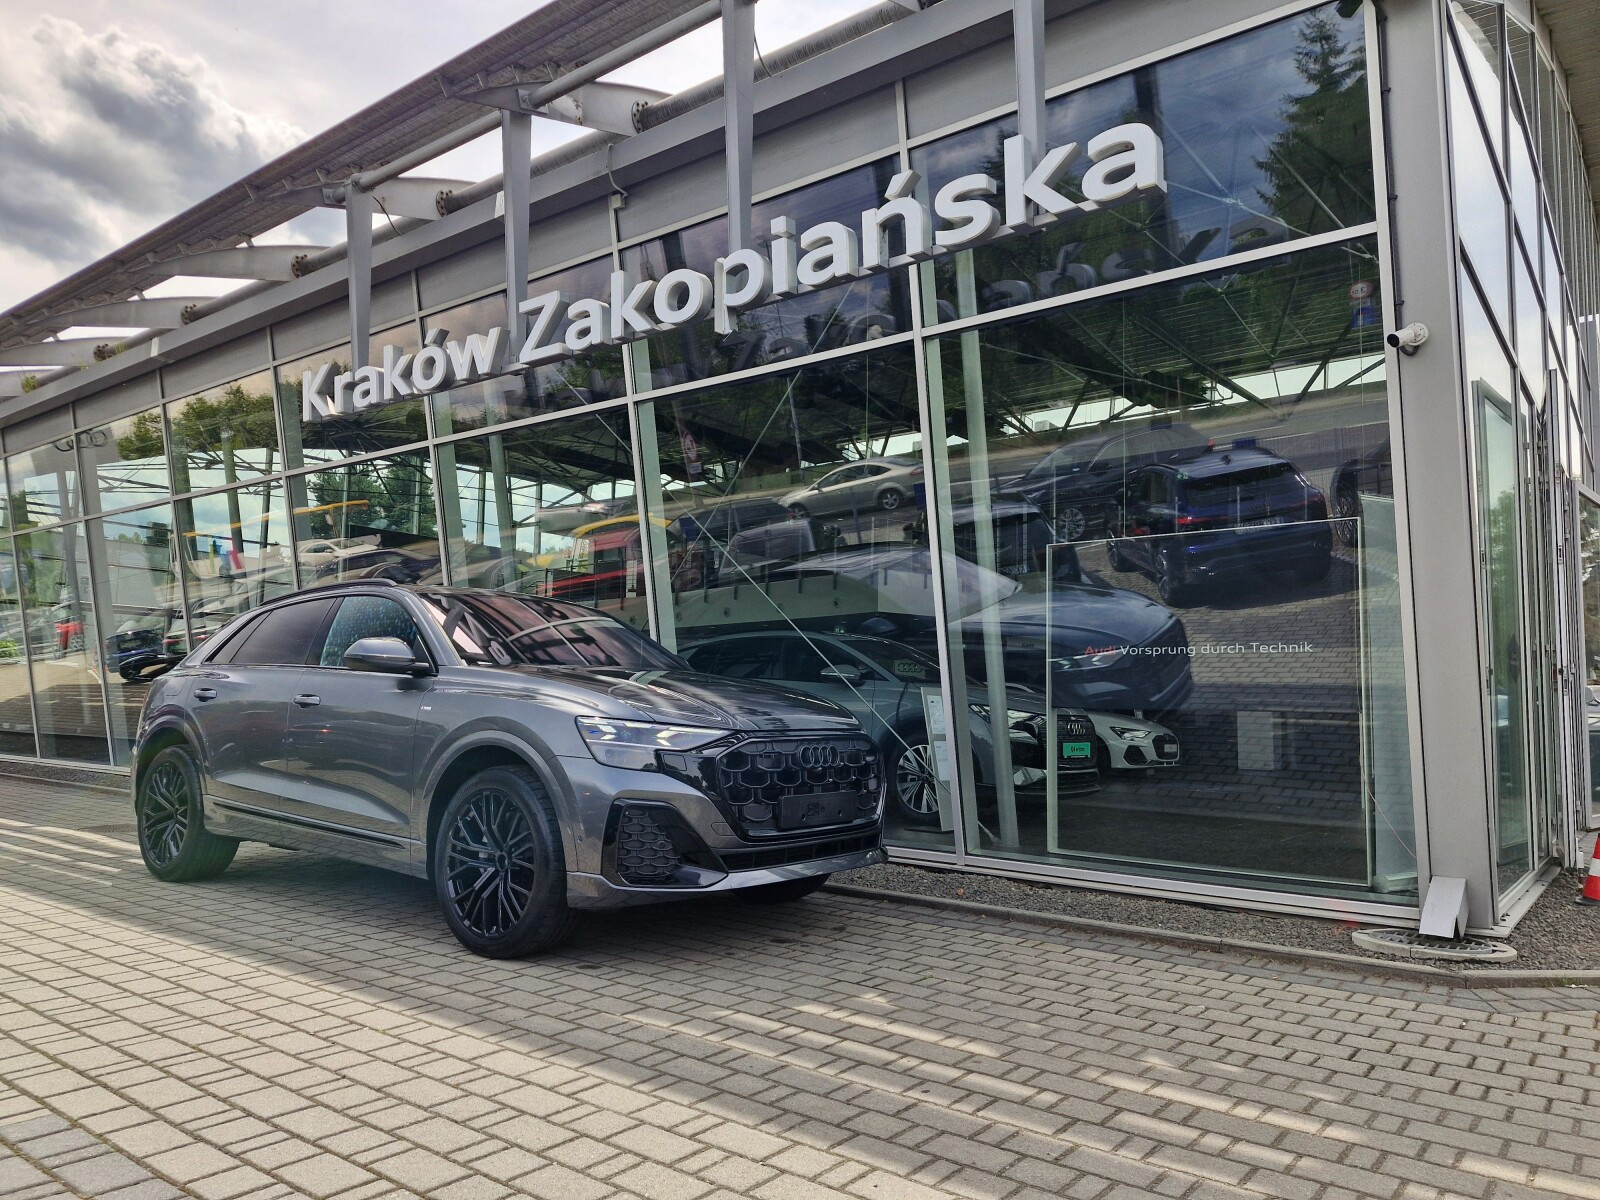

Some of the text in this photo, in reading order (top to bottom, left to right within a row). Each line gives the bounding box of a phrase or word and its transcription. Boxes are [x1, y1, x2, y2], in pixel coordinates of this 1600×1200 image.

[302, 326, 509, 422] Kraków
[518, 122, 1166, 364] Zakopiańska
[1084, 641, 1314, 657] Audi Vorsprung durch Technik
